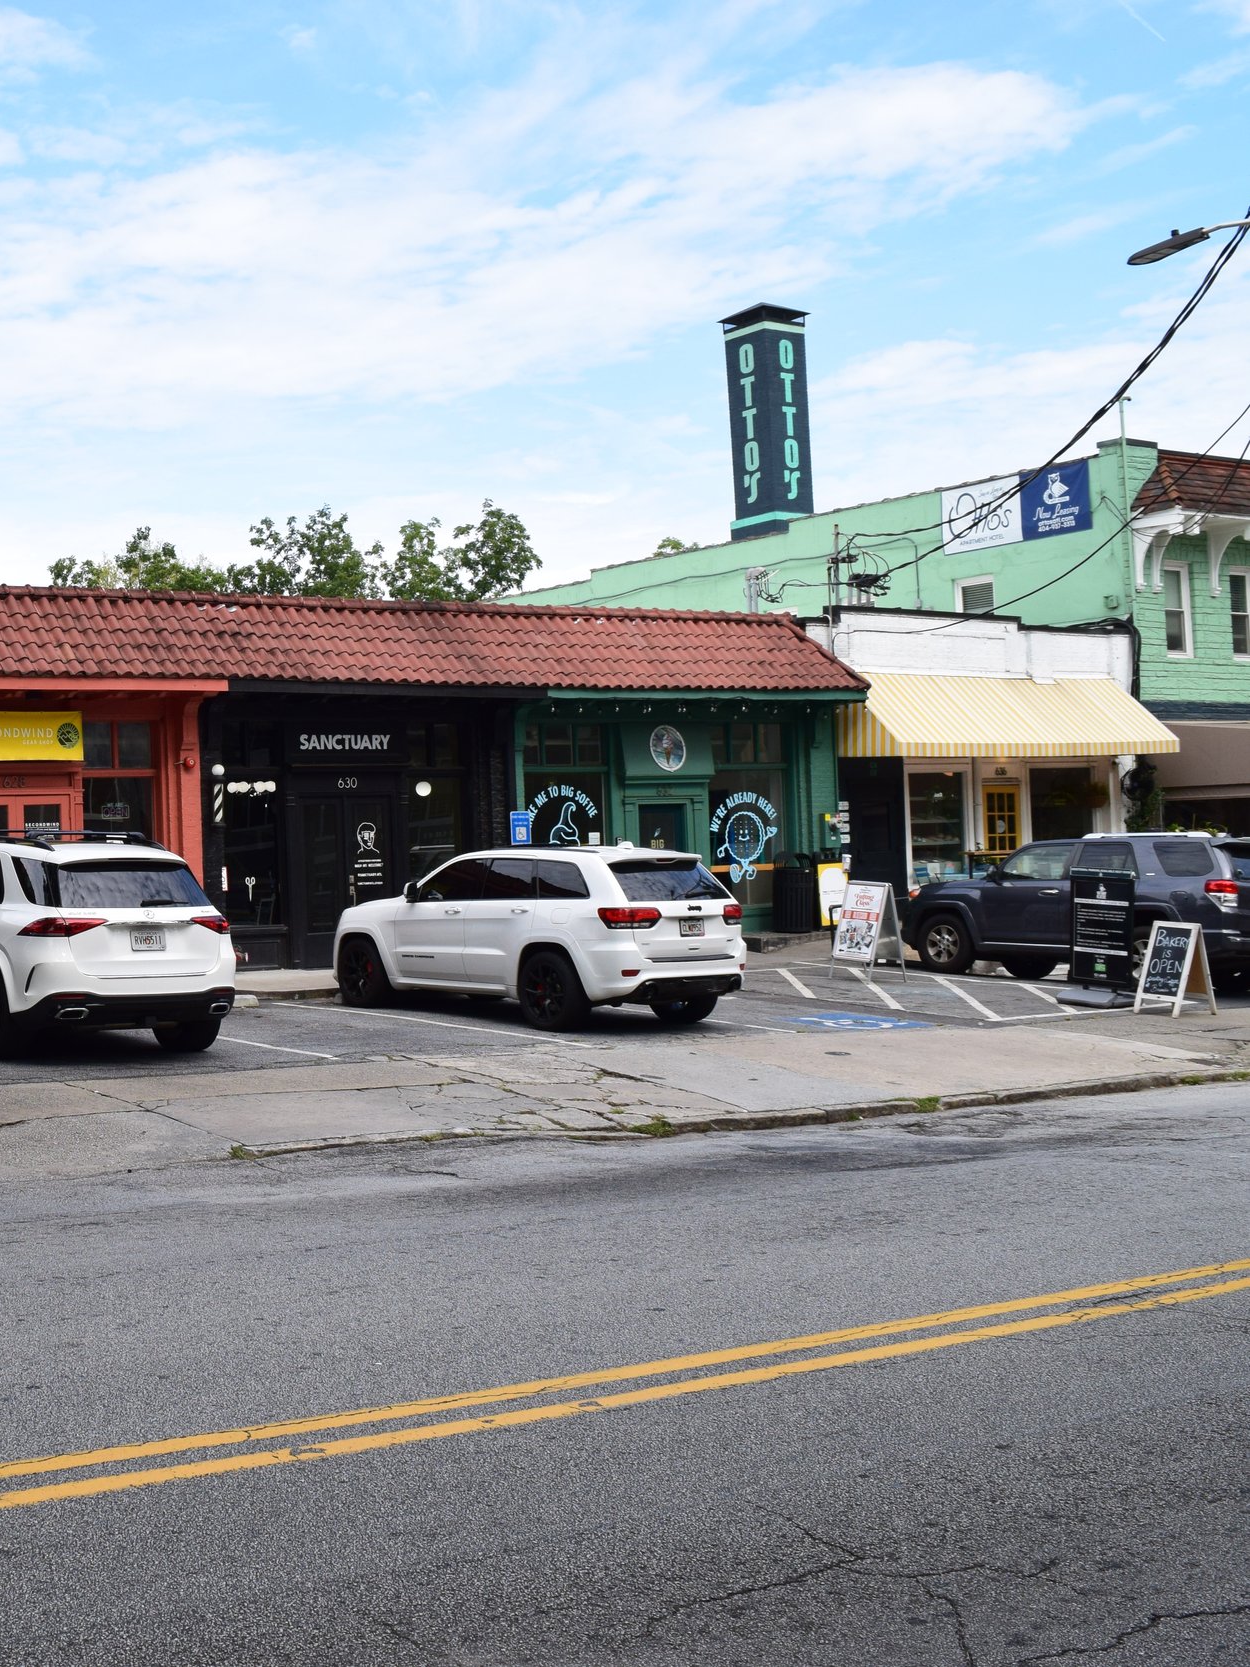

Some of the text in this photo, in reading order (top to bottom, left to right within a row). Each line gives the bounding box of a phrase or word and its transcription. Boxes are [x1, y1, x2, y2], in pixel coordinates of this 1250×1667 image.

[739, 343, 761, 504] OTTO'S
[778, 339, 801, 500] OTTO'S
[1033, 503, 1079, 521] Now Leasing
[959, 533, 1004, 546] APARTMENT HOTEL
[299, 733, 391, 750] SANCTUARY
[3, 775, 26, 788] 628
[337, 777, 357, 788] 630
[534, 790, 548, 808] ME
[547, 785, 559, 798] TO
[560, 784, 575, 798] BIG
[574, 790, 598, 819] SOFTIE
[103, 807, 128, 818] OPEN
[710, 791, 778, 833] WE'RE ALREADY HERE!
[650, 839, 665, 849] BIG
[687, 904, 702, 912] Jeep
[1155, 929, 1190, 950] BAKERY
[1150, 958, 1185, 974] OPEN
